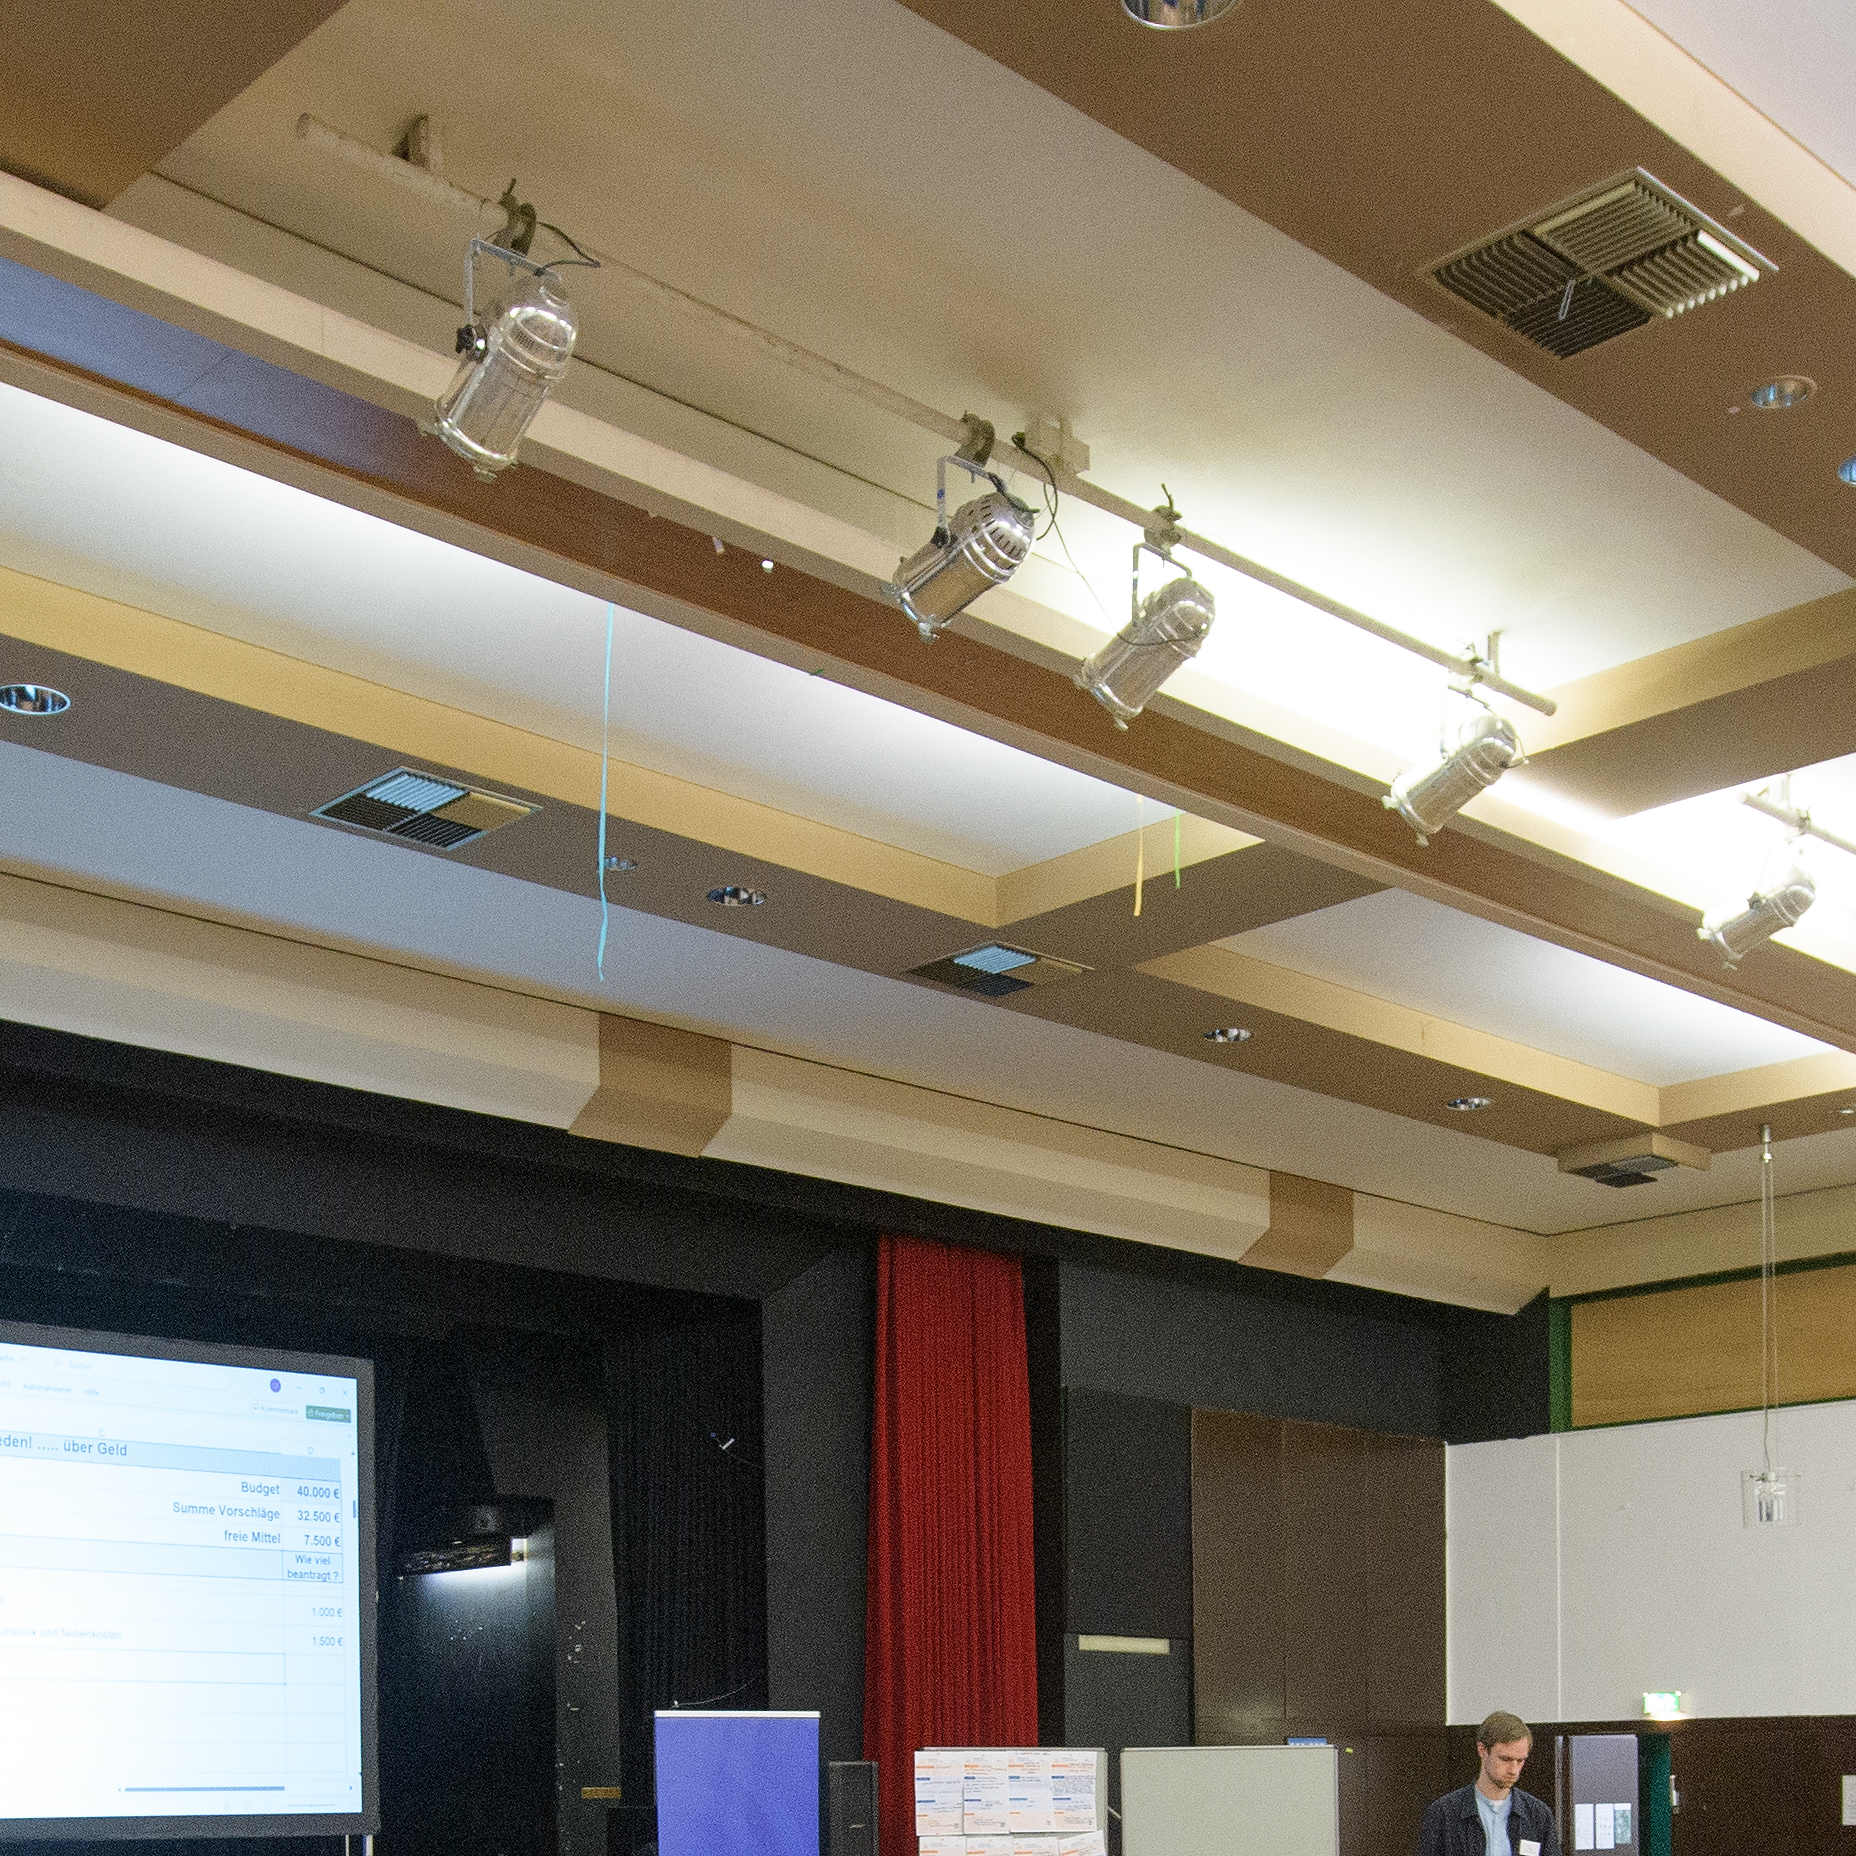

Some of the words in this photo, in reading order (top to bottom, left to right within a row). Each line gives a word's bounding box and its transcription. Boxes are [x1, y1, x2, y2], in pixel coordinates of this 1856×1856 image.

[63, 1439, 92, 1454] über
[97, 1442, 128, 1456] Geld
[241, 1481, 280, 1497] Budget
[297, 1485, 331, 1499] 40.000
[172, 1502, 216, 1515] Summe
[219, 1504, 280, 1522] Vorschläge
[297, 1509, 331, 1523] 32.500
[224, 1530, 249, 1543] freie
[251, 1531, 281, 1544] Mittel
[304, 1534, 332, 1547] 7.500
[295, 1554, 312, 1565] Wie
[287, 1569, 331, 1582] beantragt
